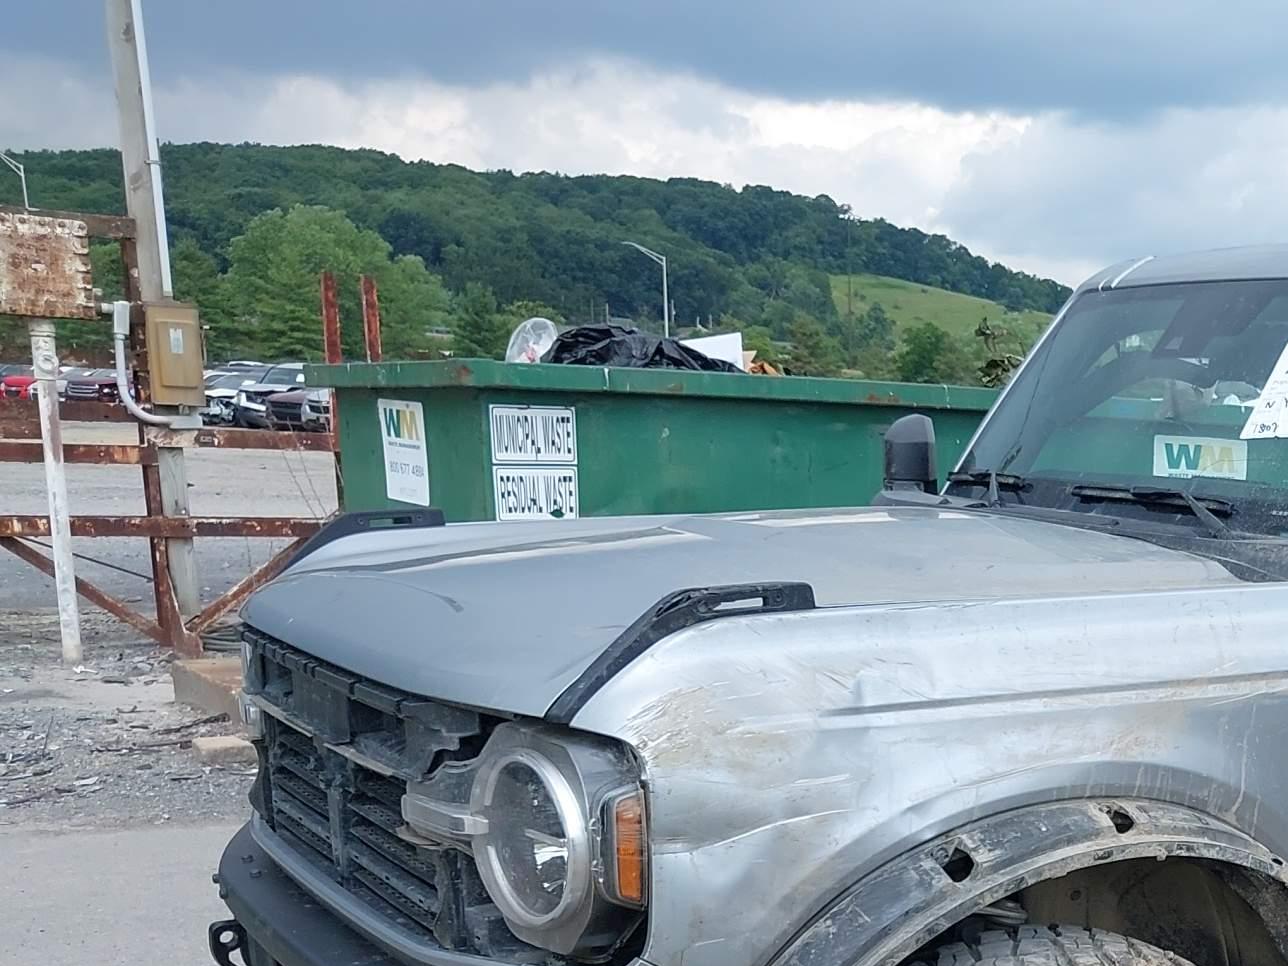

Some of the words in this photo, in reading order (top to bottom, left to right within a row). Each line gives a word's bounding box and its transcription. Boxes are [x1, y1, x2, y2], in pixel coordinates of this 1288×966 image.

[383, 407, 420, 441] WM
[495, 414, 542, 454] MUNICIPAL
[542, 415, 572, 455] WASTE
[1164, 442, 1235, 473] WM
[500, 475, 544, 514] RESIDUAL
[544, 475, 574, 514] WASTE
